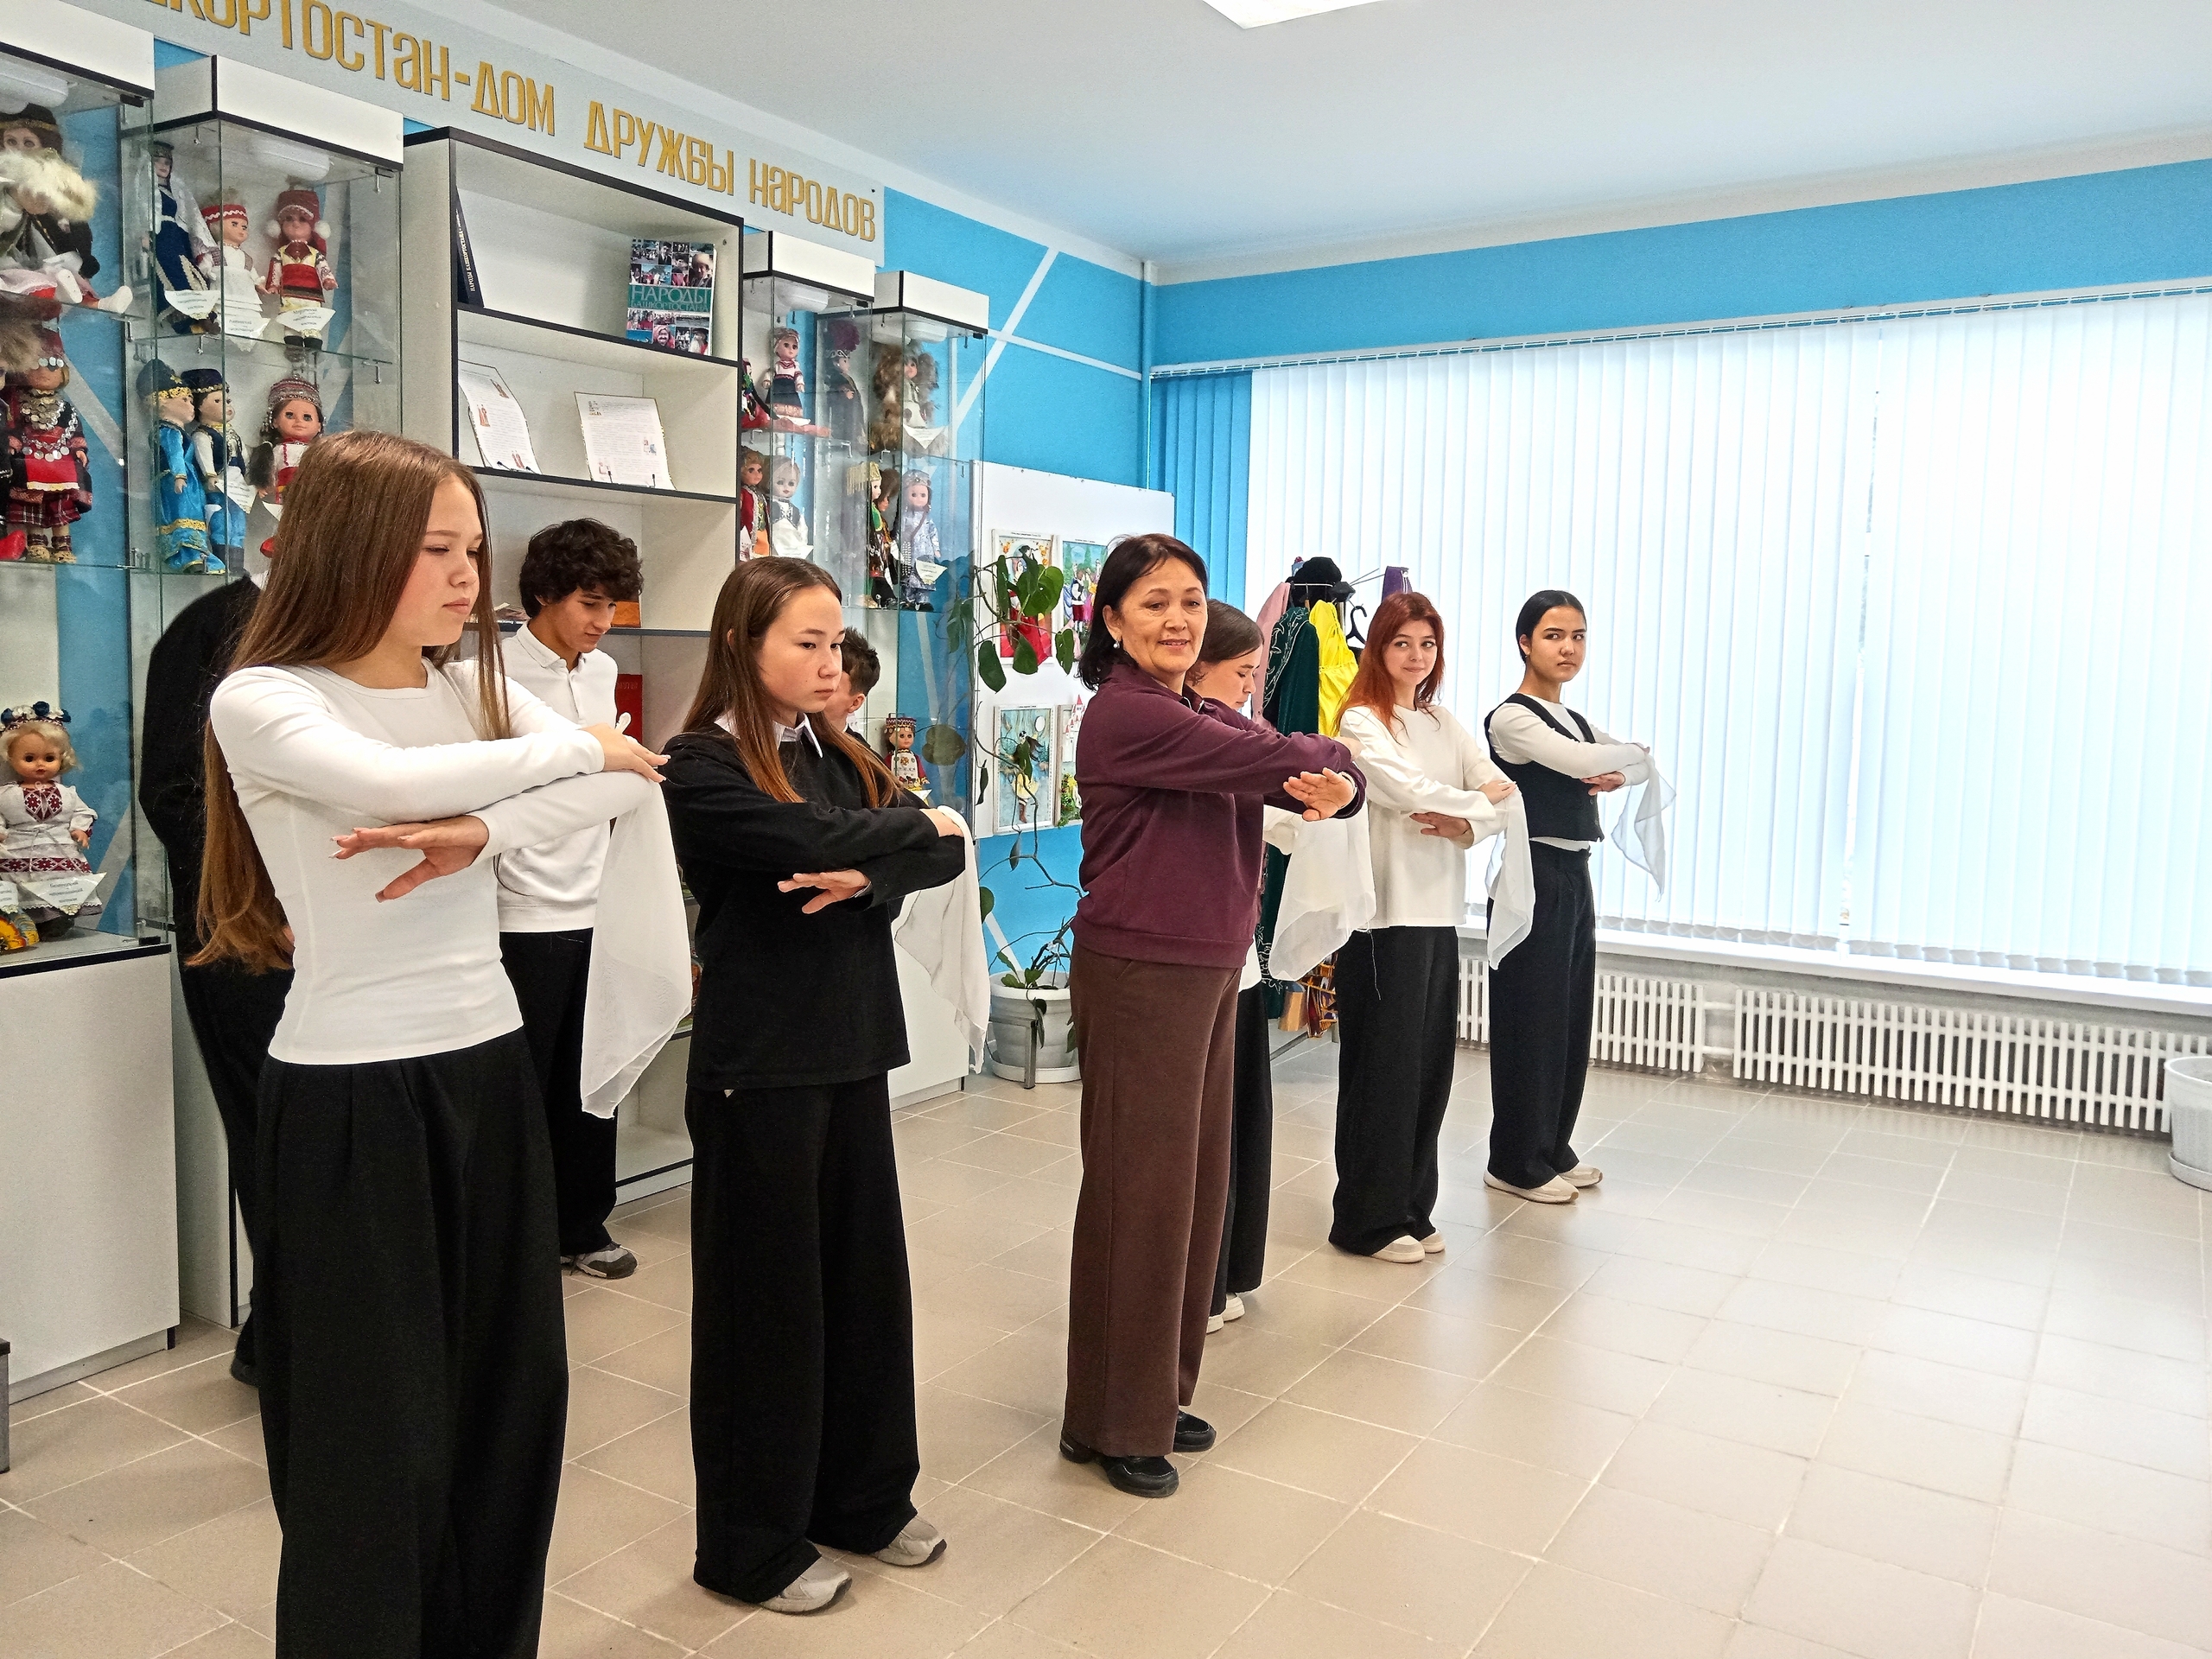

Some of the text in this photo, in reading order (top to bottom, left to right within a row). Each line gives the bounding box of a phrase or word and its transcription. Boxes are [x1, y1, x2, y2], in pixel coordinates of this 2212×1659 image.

[583, 100, 734, 196] ДРУЖБЫ
[632, 286, 708, 303] НАРОДЫ
[631, 300, 709, 312] БАШКОРТОСТАНА
